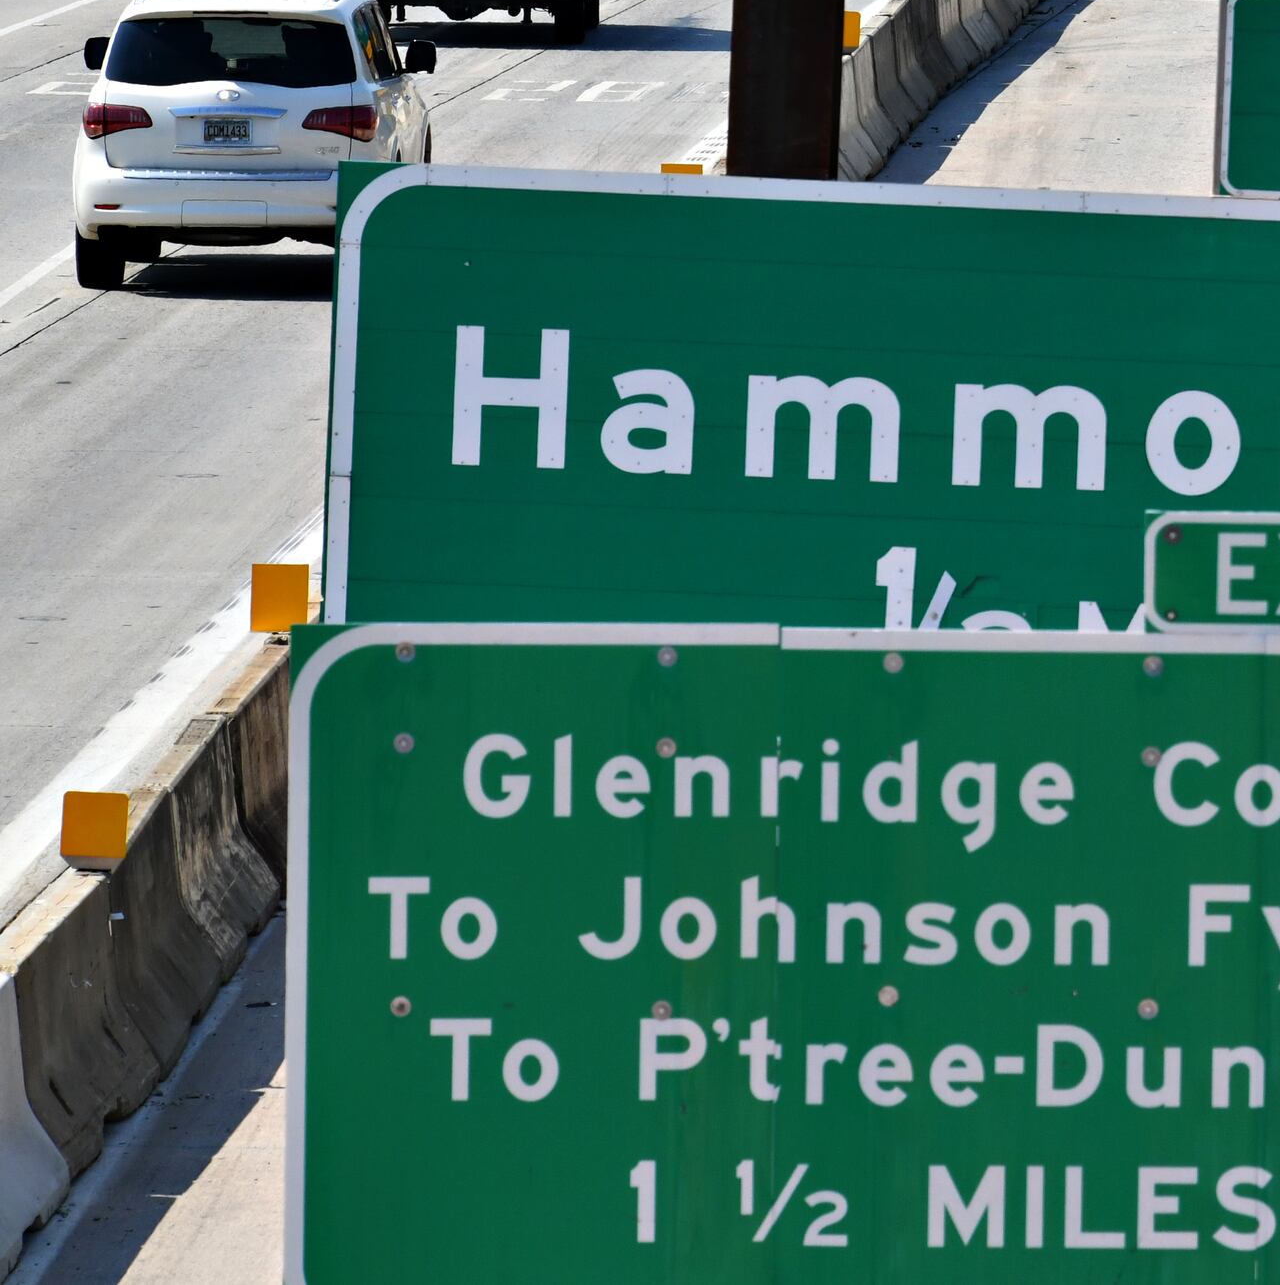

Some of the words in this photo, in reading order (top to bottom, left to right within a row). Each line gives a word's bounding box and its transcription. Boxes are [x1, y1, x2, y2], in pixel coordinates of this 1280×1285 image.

[463, 734, 1077, 854] Glenridge
[367, 876, 498, 960] To
[578, 875, 1110, 966] Johnson
[429, 1017, 559, 1102] To
[639, 1017, 1264, 1109] P'tree-Dun
[927, 1164, 1277, 1251] MILES
